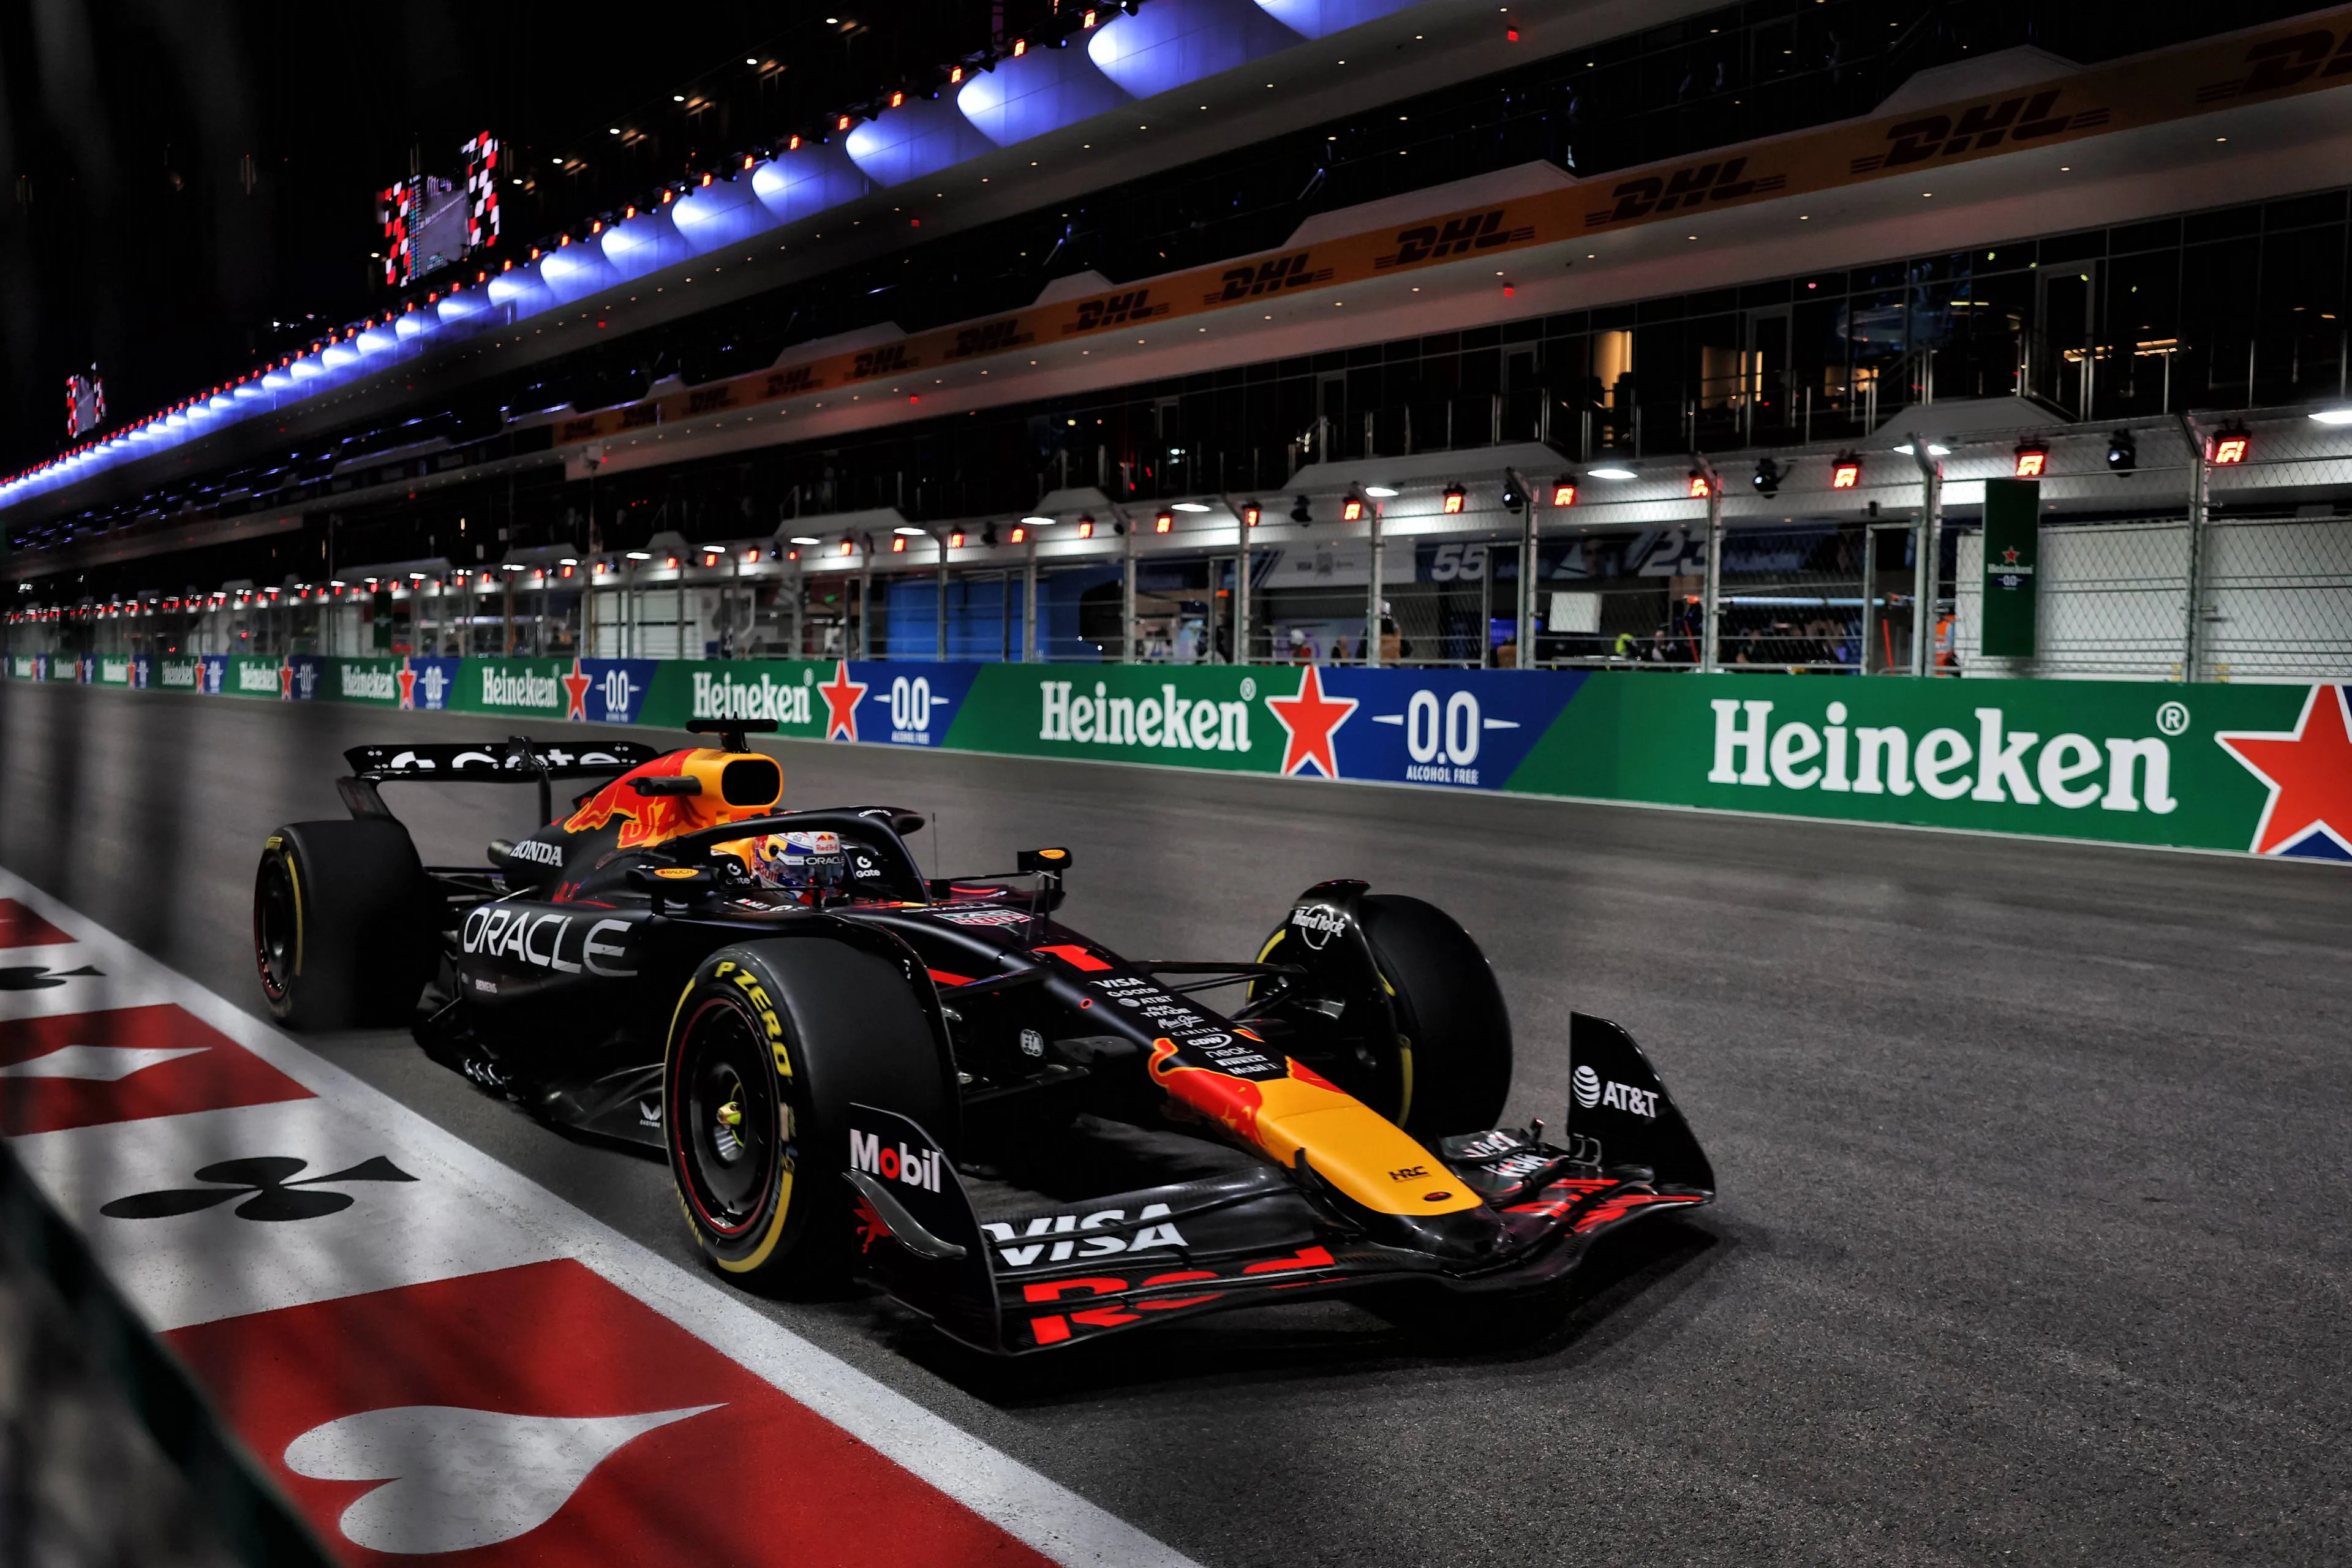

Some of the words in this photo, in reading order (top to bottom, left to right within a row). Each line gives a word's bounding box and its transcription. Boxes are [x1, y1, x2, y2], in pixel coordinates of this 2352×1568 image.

[1883, 89, 2075, 168] DHL
[1610, 157, 1755, 221] DHL
[1395, 209, 1510, 264] DHL
[1221, 254, 1313, 300] DHL
[1077, 289, 1153, 330] DHL
[956, 319, 1022, 356] DHL
[854, 345, 911, 378] DHL
[690, 386, 732, 413] DHL
[766, 368, 815, 396] DHL
[1431, 544, 1485, 581] 55
[481, 666, 558, 707] Heineken
[693, 672, 812, 724] Heineken
[891, 676, 930, 731] 0.0
[1407, 689, 1480, 766] 0.0
[1406, 765, 1450, 783] ALCOHOL
[1453, 768, 1479, 785] FREE
[510, 840, 564, 867] HONDA
[856, 868, 881, 878] Gate
[463, 907, 638, 977] ORACLE
[1090, 978, 1147, 988] VISA
[1139, 995, 1174, 1005] AT&T
[1171, 1027, 1222, 1036] CARLYLE
[1186, 1036, 1223, 1046] CDW
[1214, 1054, 1268, 1066] PIRELLI
[1227, 1063, 1268, 1075] Mobil
[1603, 1080, 1659, 1118] AT&T
[849, 1128, 941, 1193] Mobil
[1388, 1166, 1430, 1182] HRC
[981, 1202, 1189, 1267] VISA
